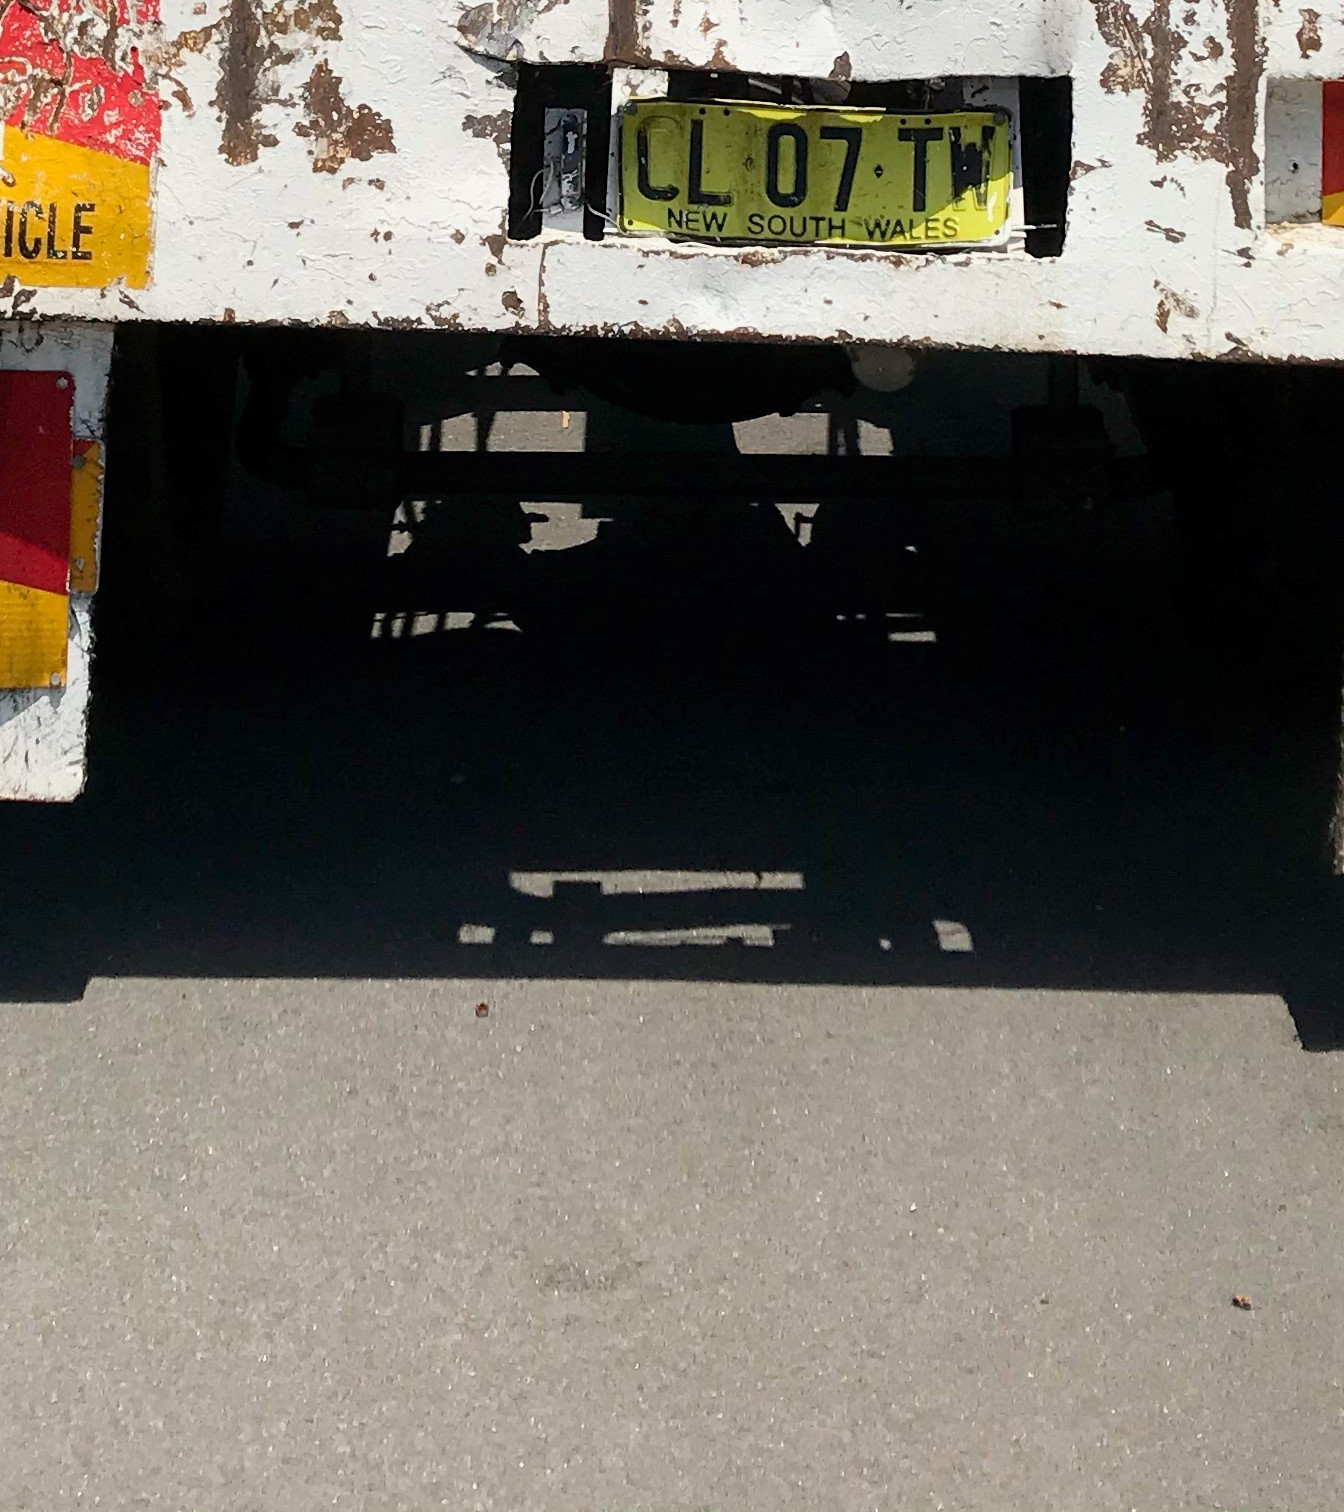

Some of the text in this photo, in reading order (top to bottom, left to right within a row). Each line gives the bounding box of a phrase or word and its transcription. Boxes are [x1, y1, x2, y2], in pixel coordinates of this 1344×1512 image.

[765, 122, 863, 213] 07
[667, 208, 959, 241] NEW SOUTH WALES
